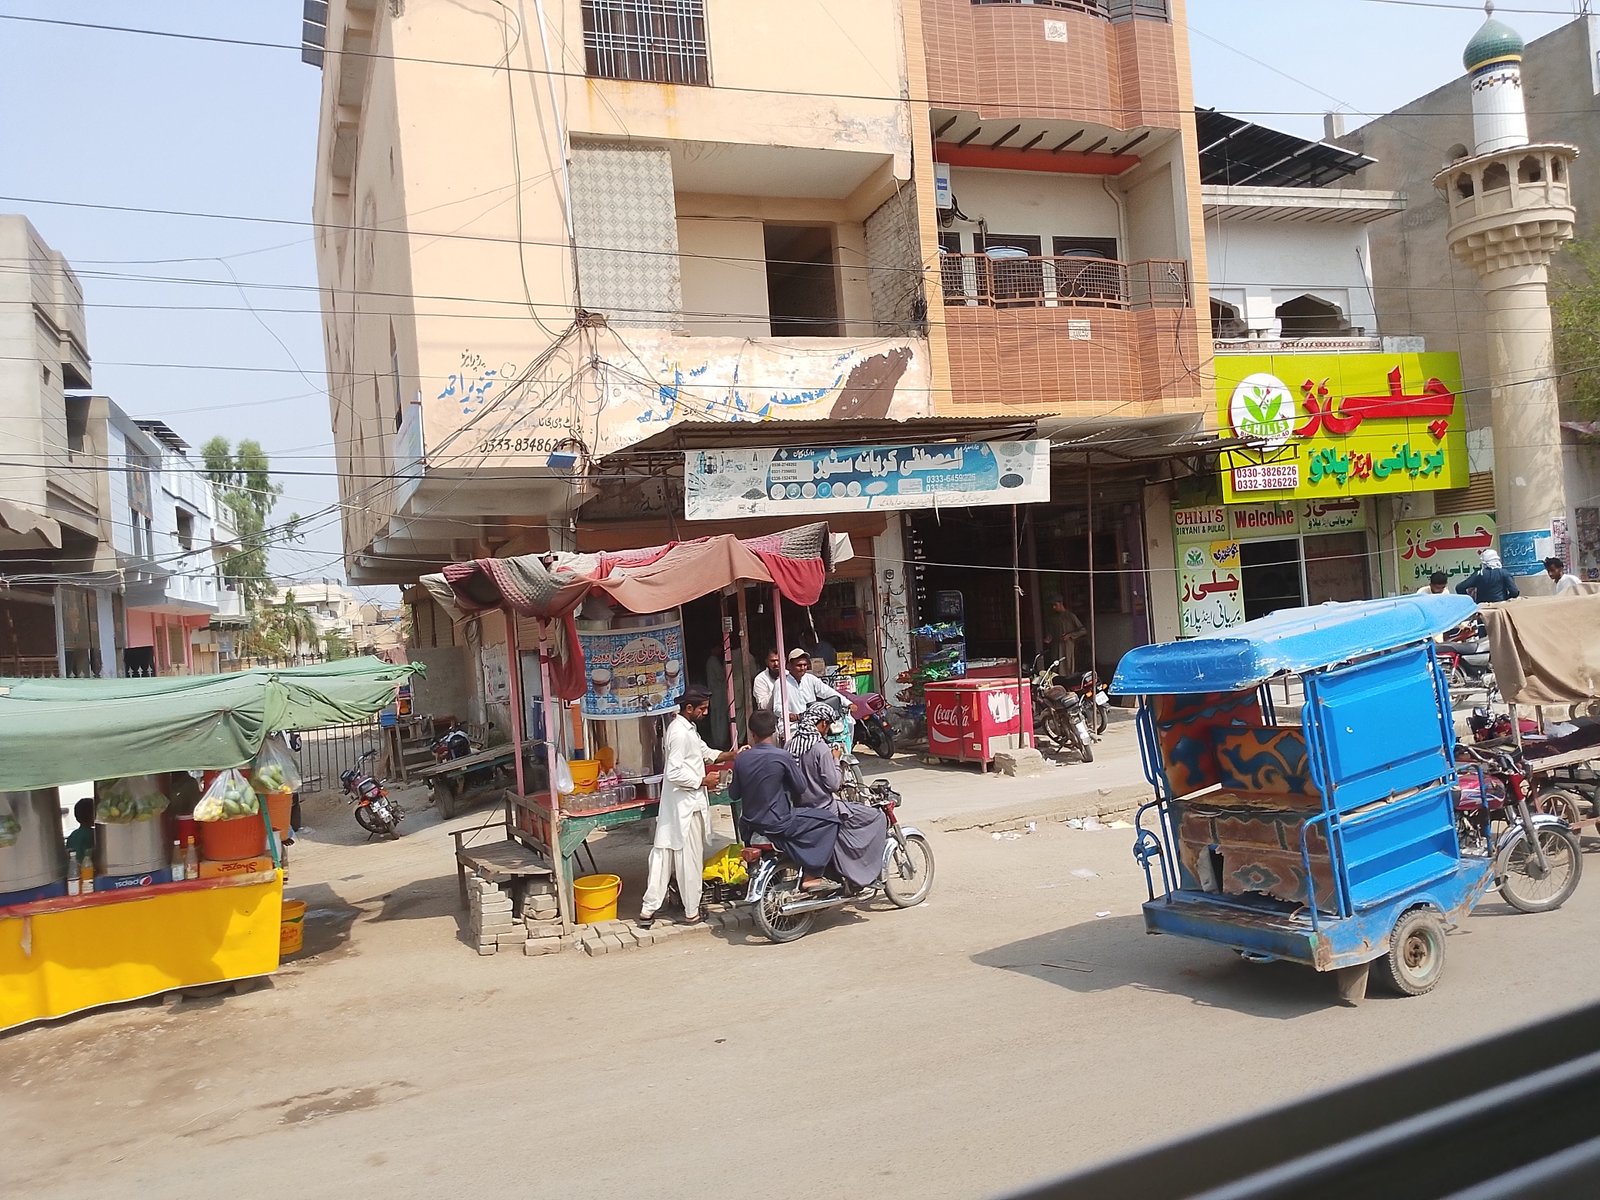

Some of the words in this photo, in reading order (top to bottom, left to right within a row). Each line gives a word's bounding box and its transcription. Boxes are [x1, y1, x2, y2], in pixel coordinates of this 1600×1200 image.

[1245, 421, 1285, 436] CHILIS
[479, 437, 565, 453] 0333-834862
[814, 449, 853, 479] سٹور
[855, 450, 898, 477] کریانہ
[1348, 449, 1373, 479] اینڈ
[1373, 443, 1445, 478] بریانی
[1236, 466, 1297, 479] 0330-3826226
[1237, 477, 1298, 490] 0332-3826226
[1175, 508, 1224, 525] CHILI'S
[1234, 509, 1294, 528] Welcome
[1176, 526, 1201, 536] BIRYANI
[1207, 524, 1226, 533] PULAO
[1202, 610, 1213, 624] اینڈ
[1213, 600, 1241, 628] بریانی
[934, 703, 970, 727] Coca-Coa
[115, 878, 139, 889] pepsi
